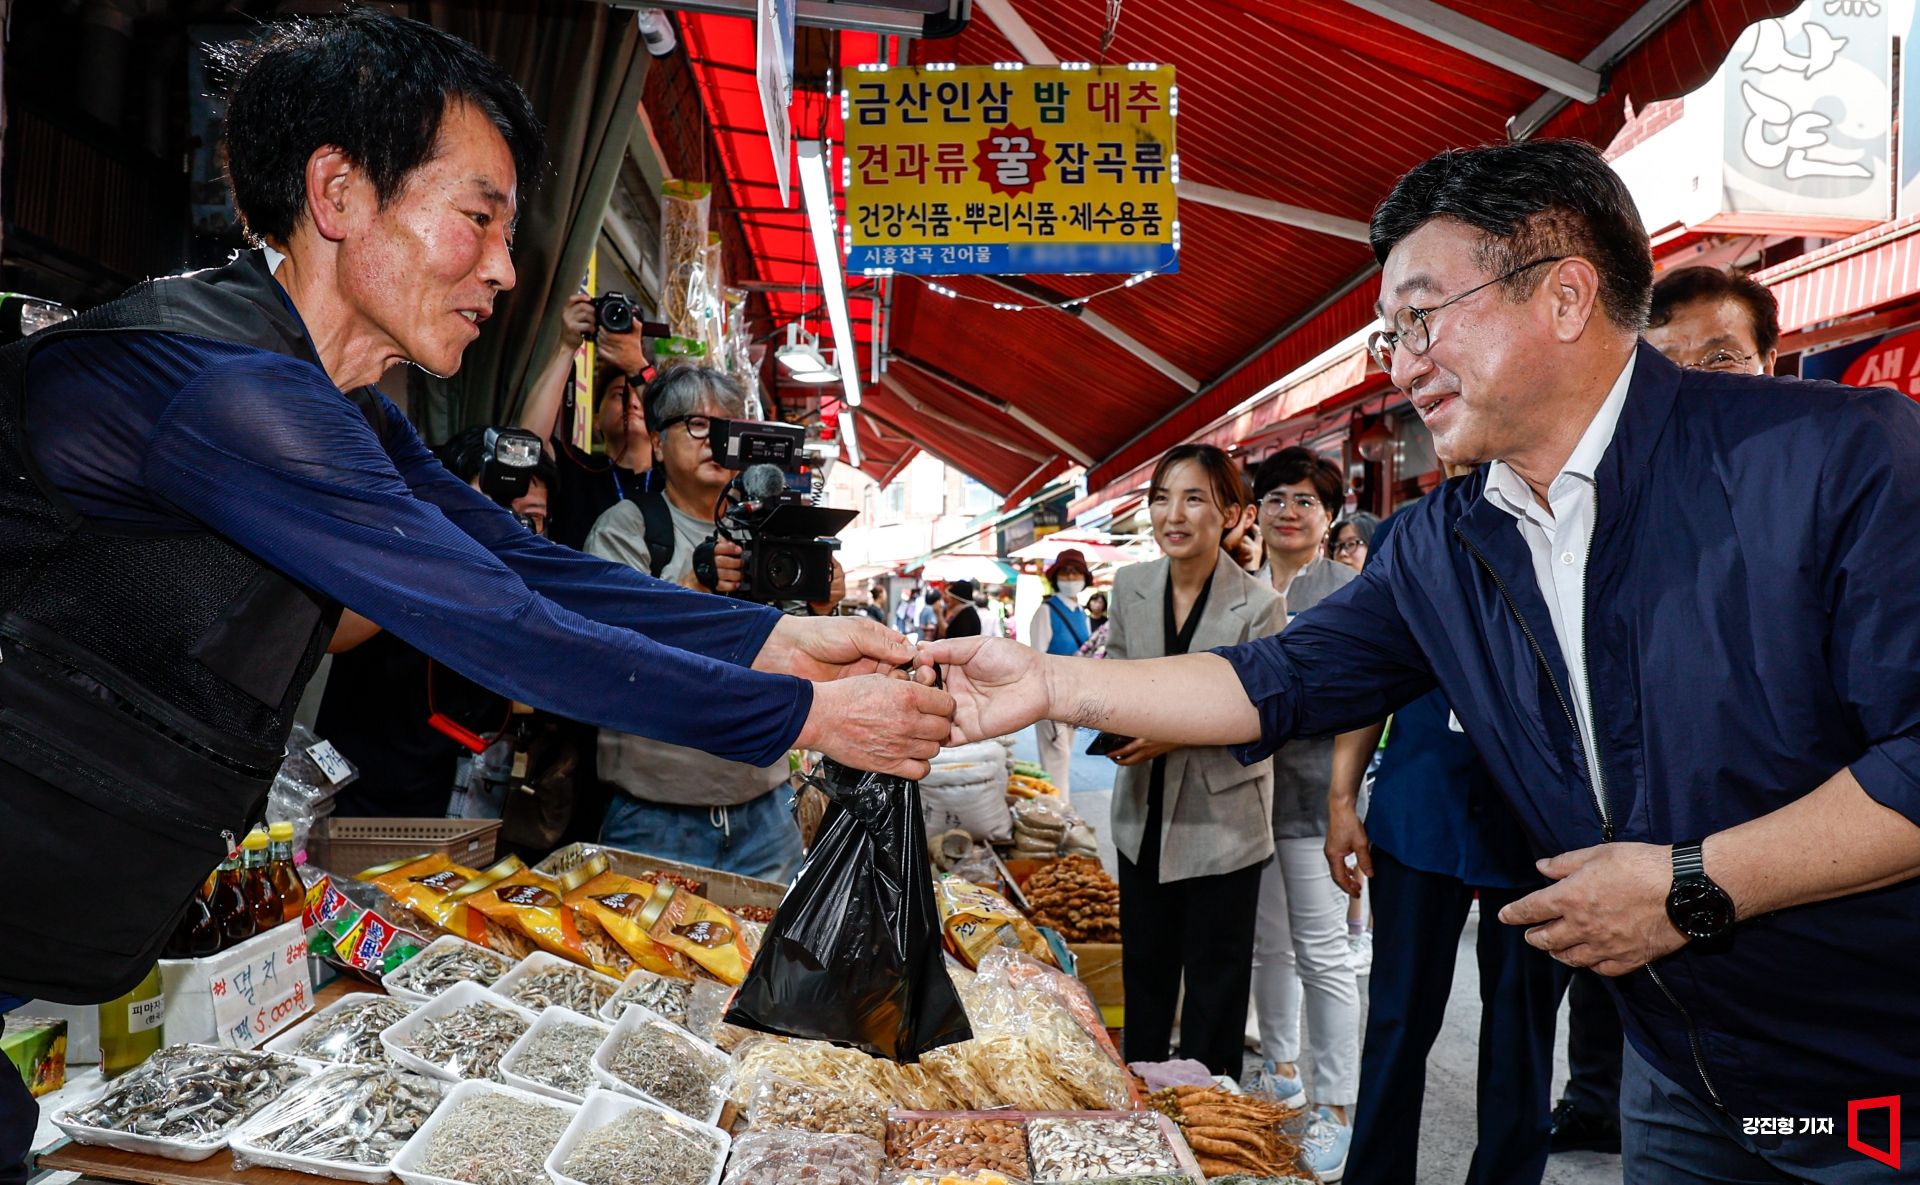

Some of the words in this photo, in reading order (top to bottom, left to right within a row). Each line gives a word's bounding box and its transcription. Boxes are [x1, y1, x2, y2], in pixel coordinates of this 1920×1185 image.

[854, 81, 1013, 125] 금산인삼
[1033, 81, 1070, 124] 밤
[1087, 80, 1162, 124] 대추
[857, 142, 969, 186] 견과류
[987, 136, 1037, 186] 꿀
[1053, 142, 1166, 185] 잡곡류
[864, 246, 935, 265] 시흥잡곡
[940, 246, 992, 264] 건어물
